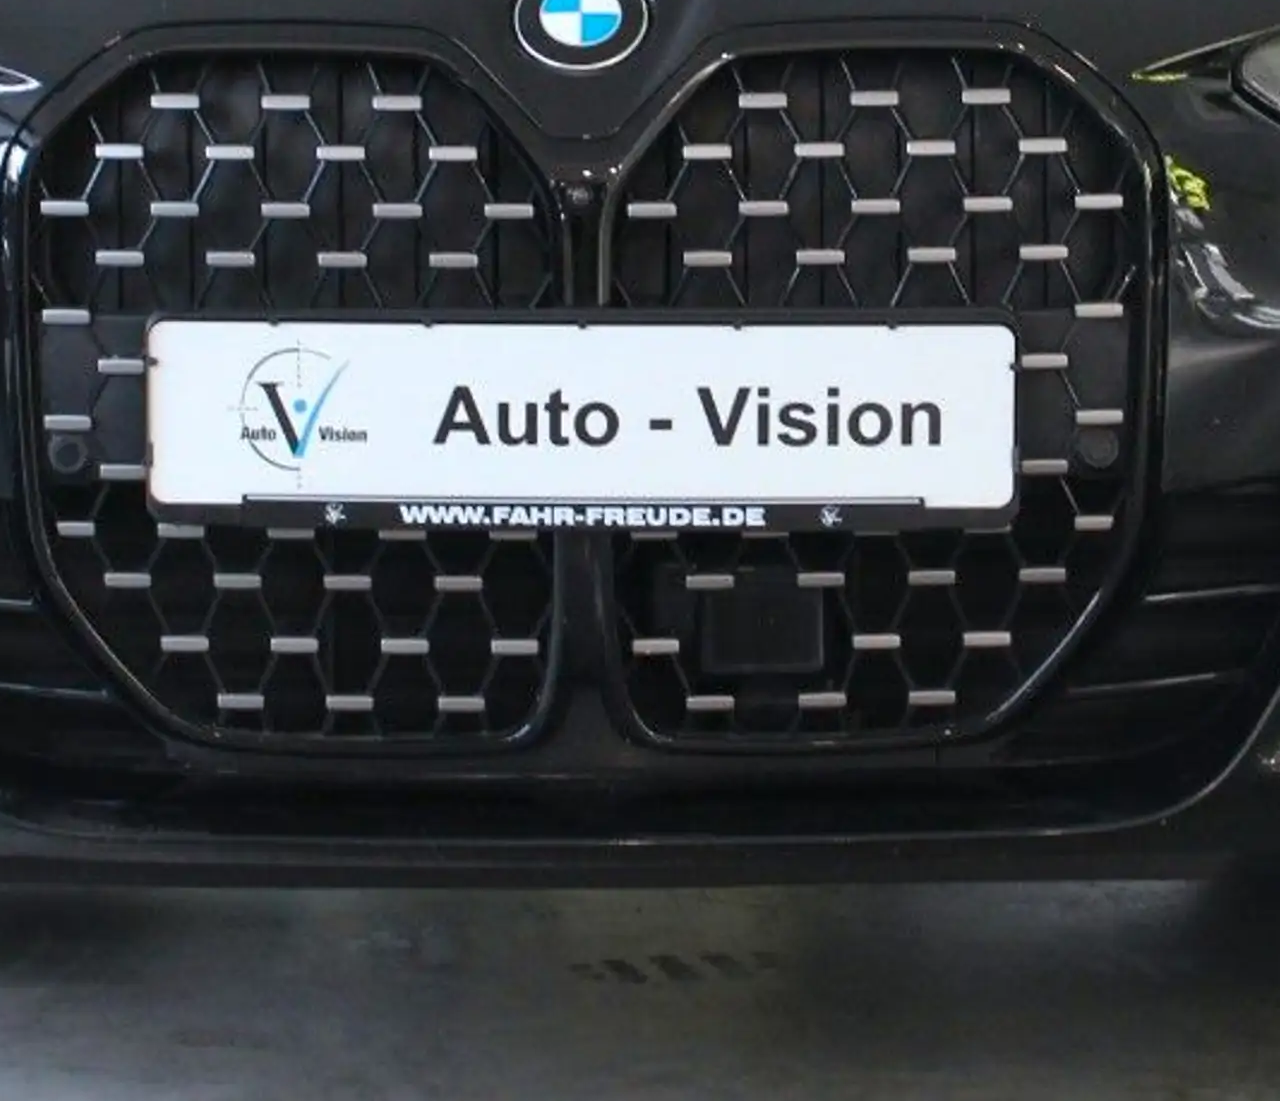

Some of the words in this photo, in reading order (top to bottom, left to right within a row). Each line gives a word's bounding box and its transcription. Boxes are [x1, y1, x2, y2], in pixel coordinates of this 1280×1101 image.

[433, 385, 620, 447] Auto
[697, 385, 941, 447] Vision
[240, 425, 278, 443] Auto
[318, 425, 368, 443] Vision
[399, 504, 767, 527] WWW.FAHR-FREUDE.DE
